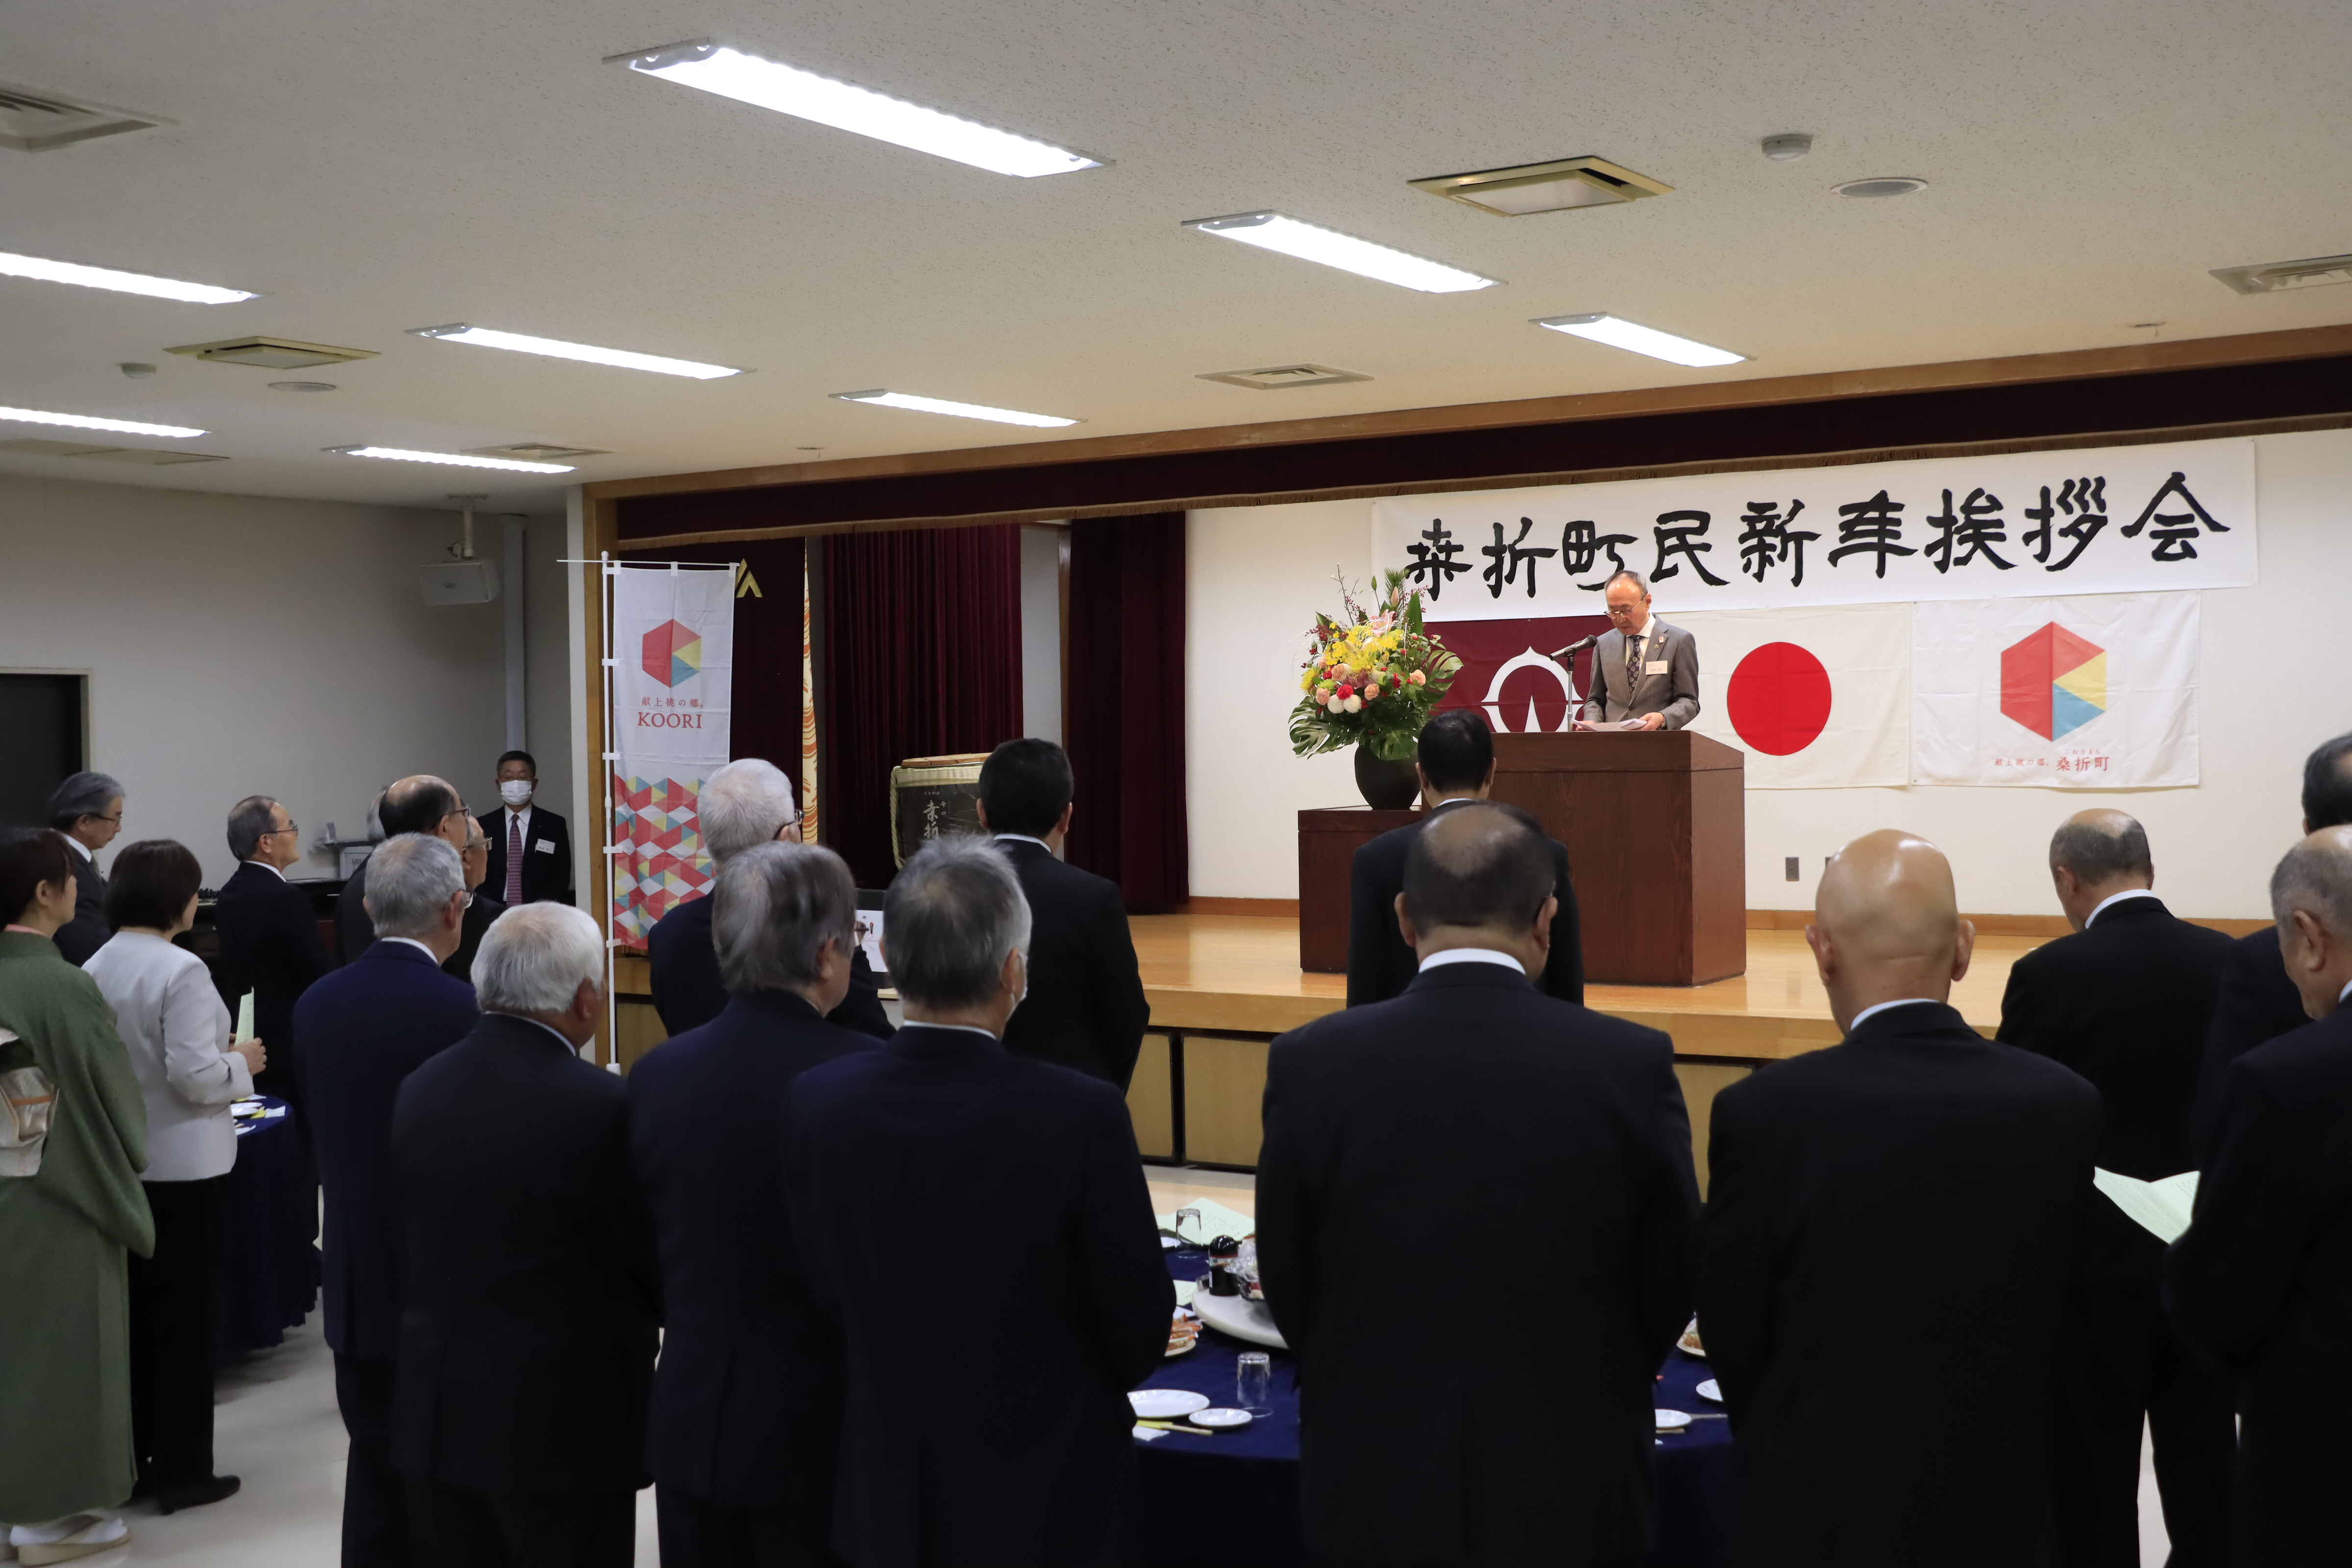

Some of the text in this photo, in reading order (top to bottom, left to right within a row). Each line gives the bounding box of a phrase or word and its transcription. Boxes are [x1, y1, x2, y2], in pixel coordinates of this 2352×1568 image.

[638, 712, 702, 729] KOORI
[2056, 756, 2110, 771] 桑折町
